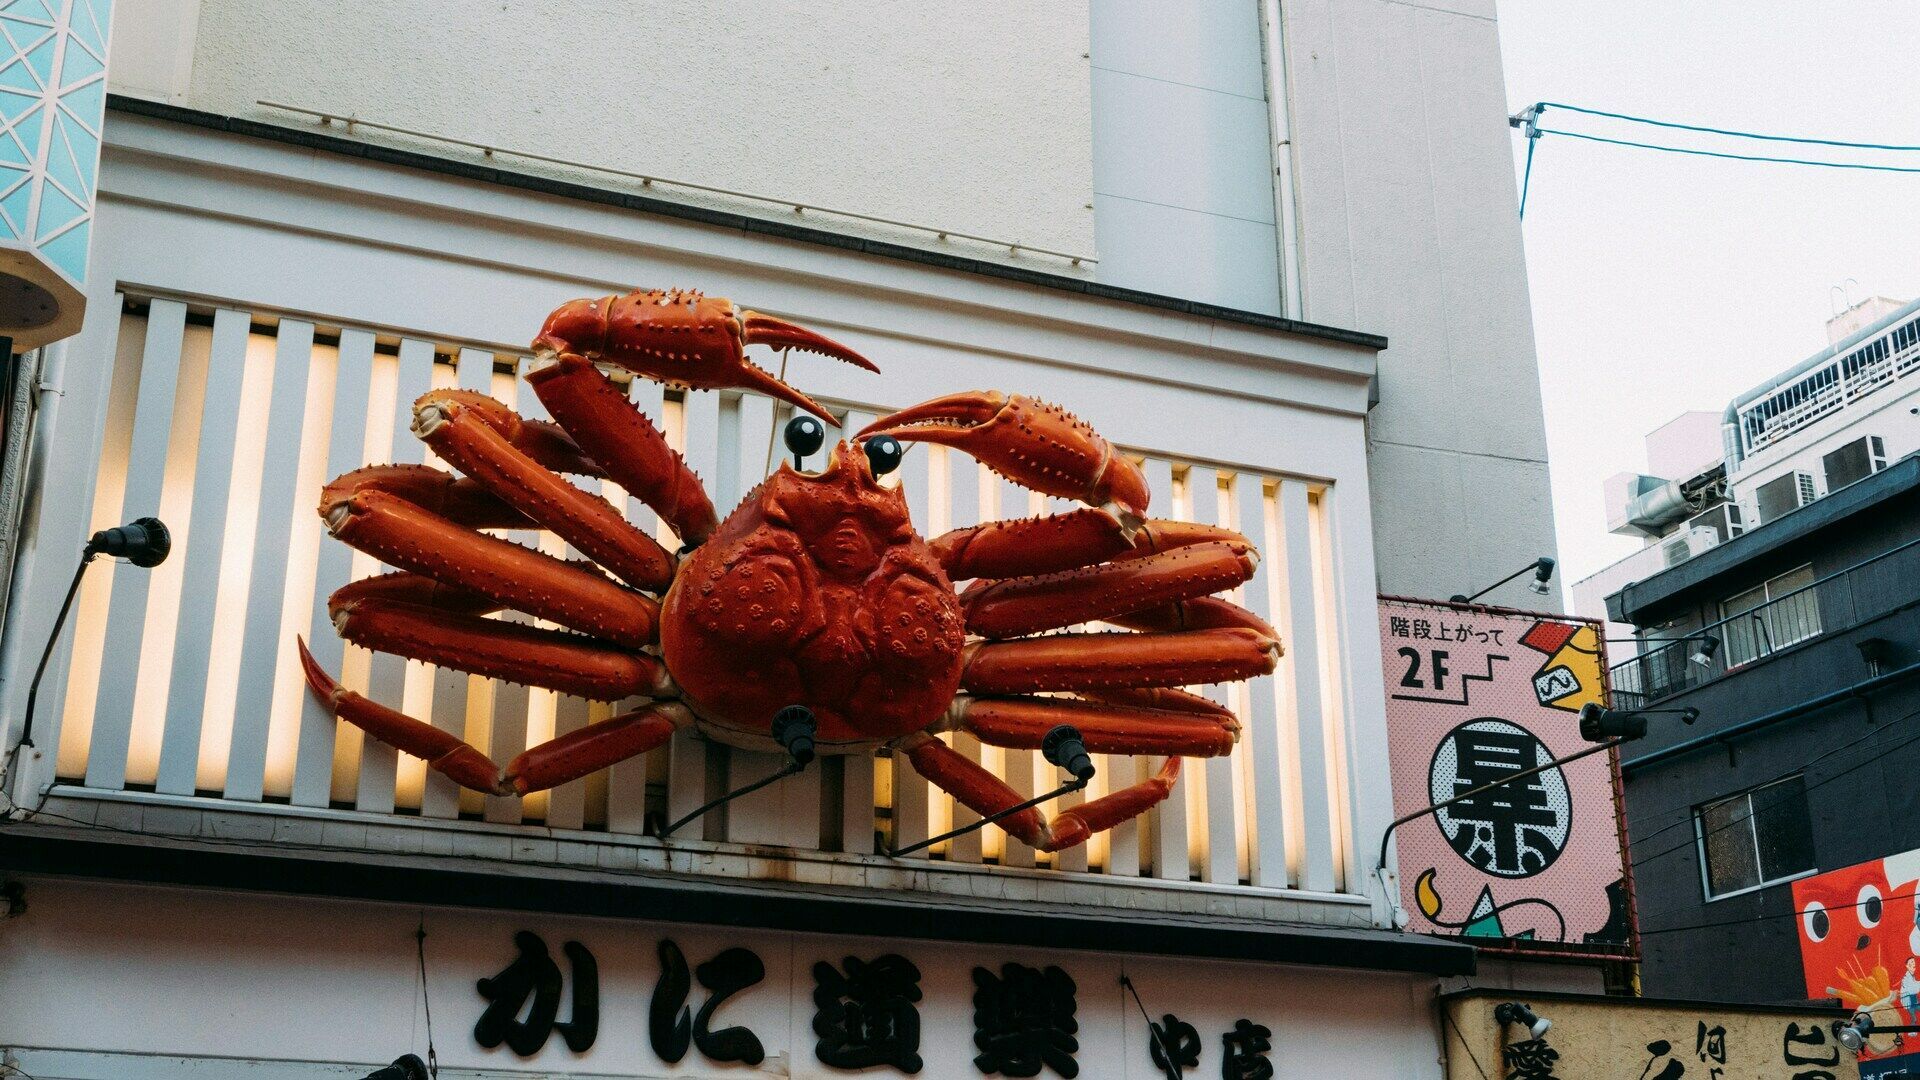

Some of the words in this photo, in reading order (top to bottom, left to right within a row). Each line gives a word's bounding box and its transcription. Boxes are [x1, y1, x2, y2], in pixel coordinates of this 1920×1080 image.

[1390, 616, 1504, 646] 階段上がって
[1397, 646, 1449, 690] 2F
